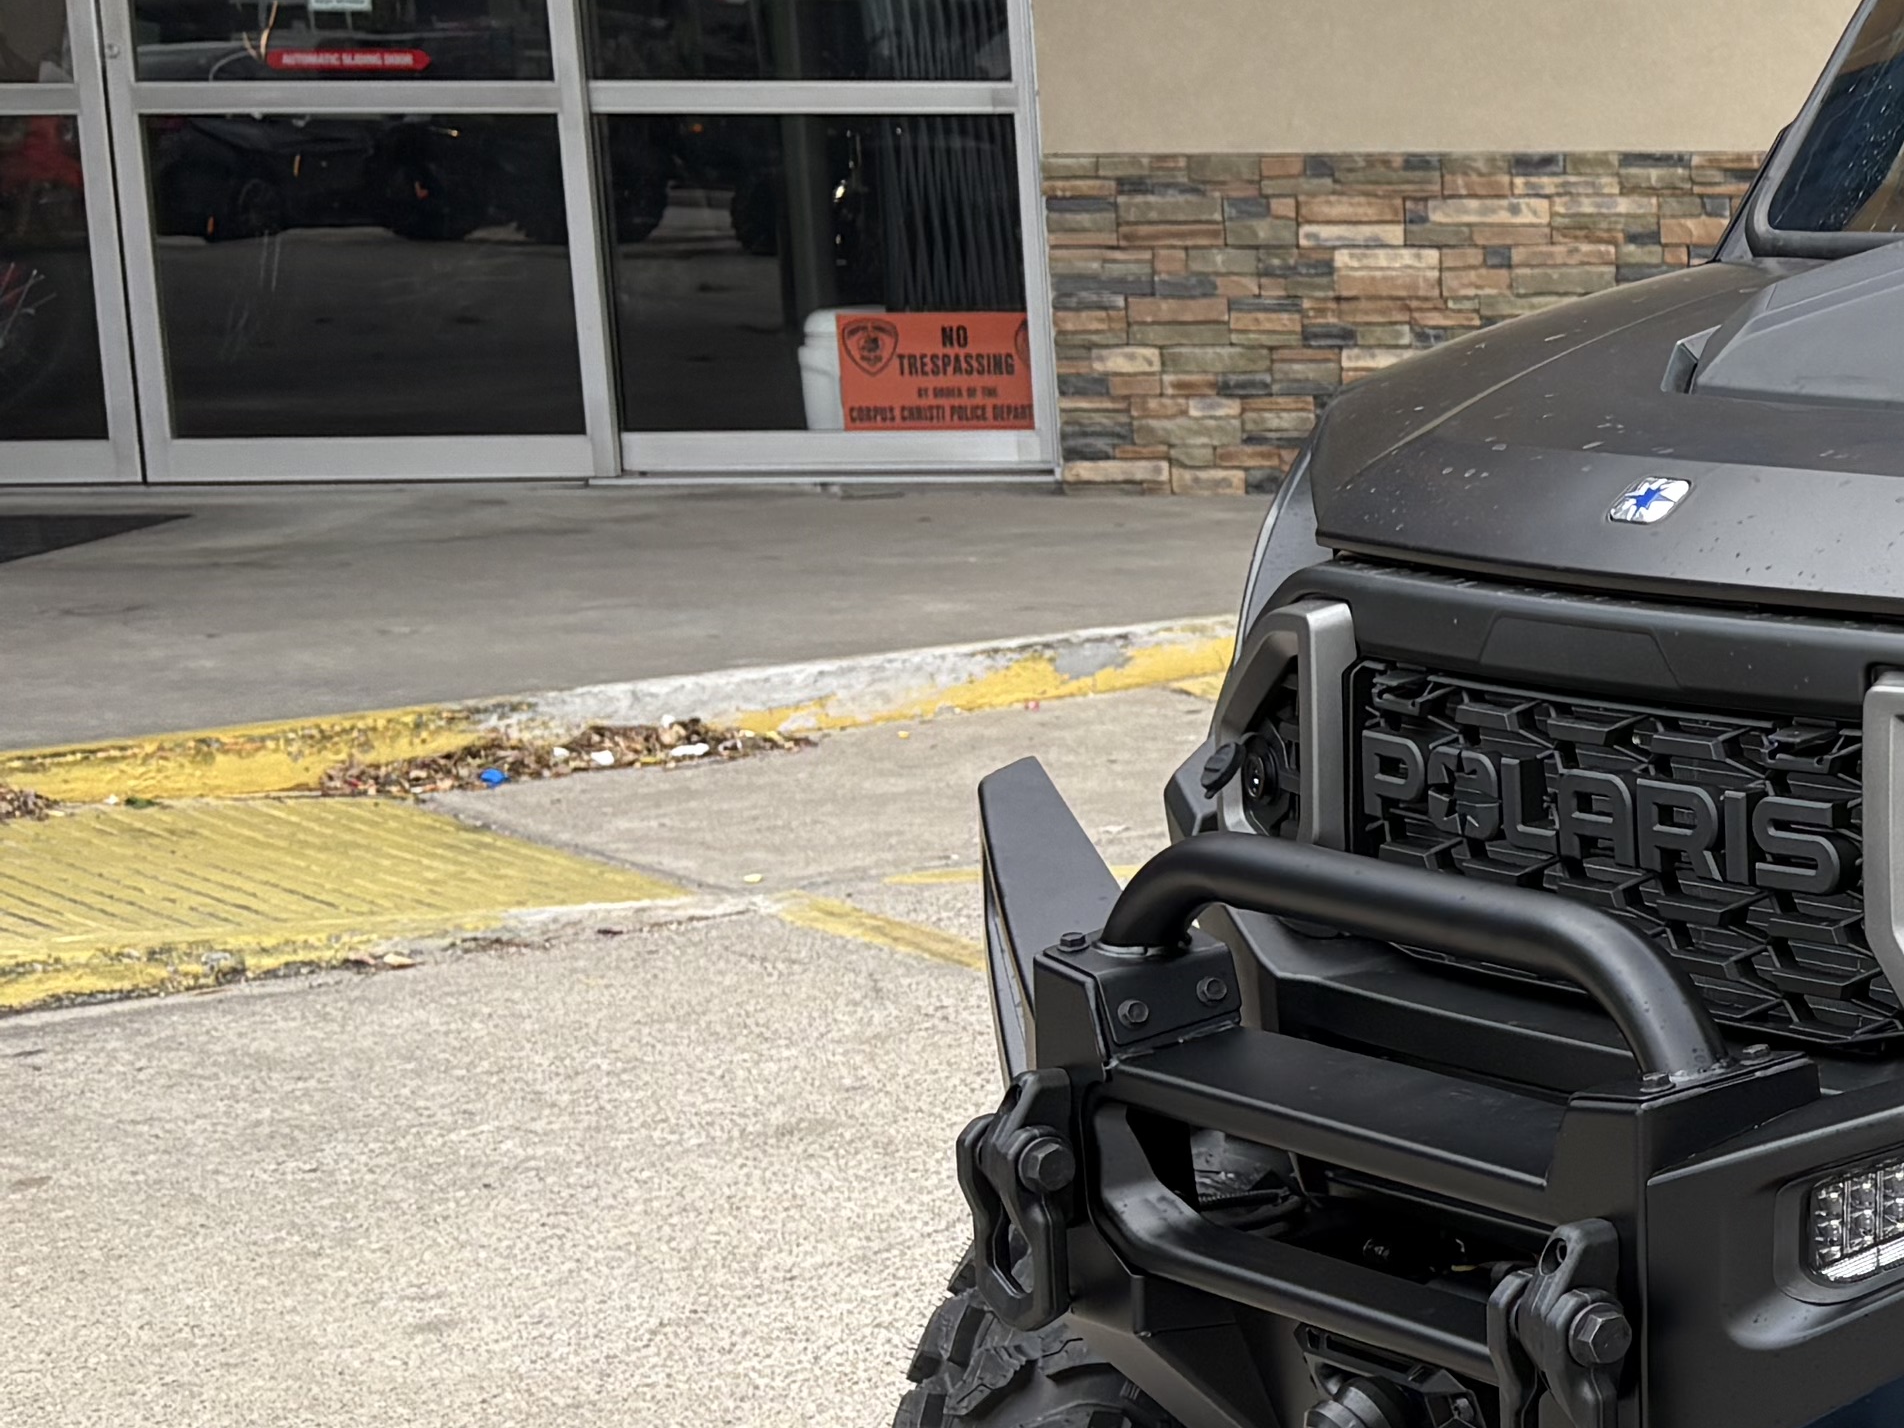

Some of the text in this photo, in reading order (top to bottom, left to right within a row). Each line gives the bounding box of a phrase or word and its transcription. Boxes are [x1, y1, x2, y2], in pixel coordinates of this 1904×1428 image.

[940, 324, 969, 349] NO
[896, 352, 1016, 377] TRESPASSING
[849, 406, 897, 423] CORPUS
[900, 405, 946, 422] CHRISTI
[950, 405, 988, 421] POLICE
[1364, 730, 1859, 896] POLARIS
